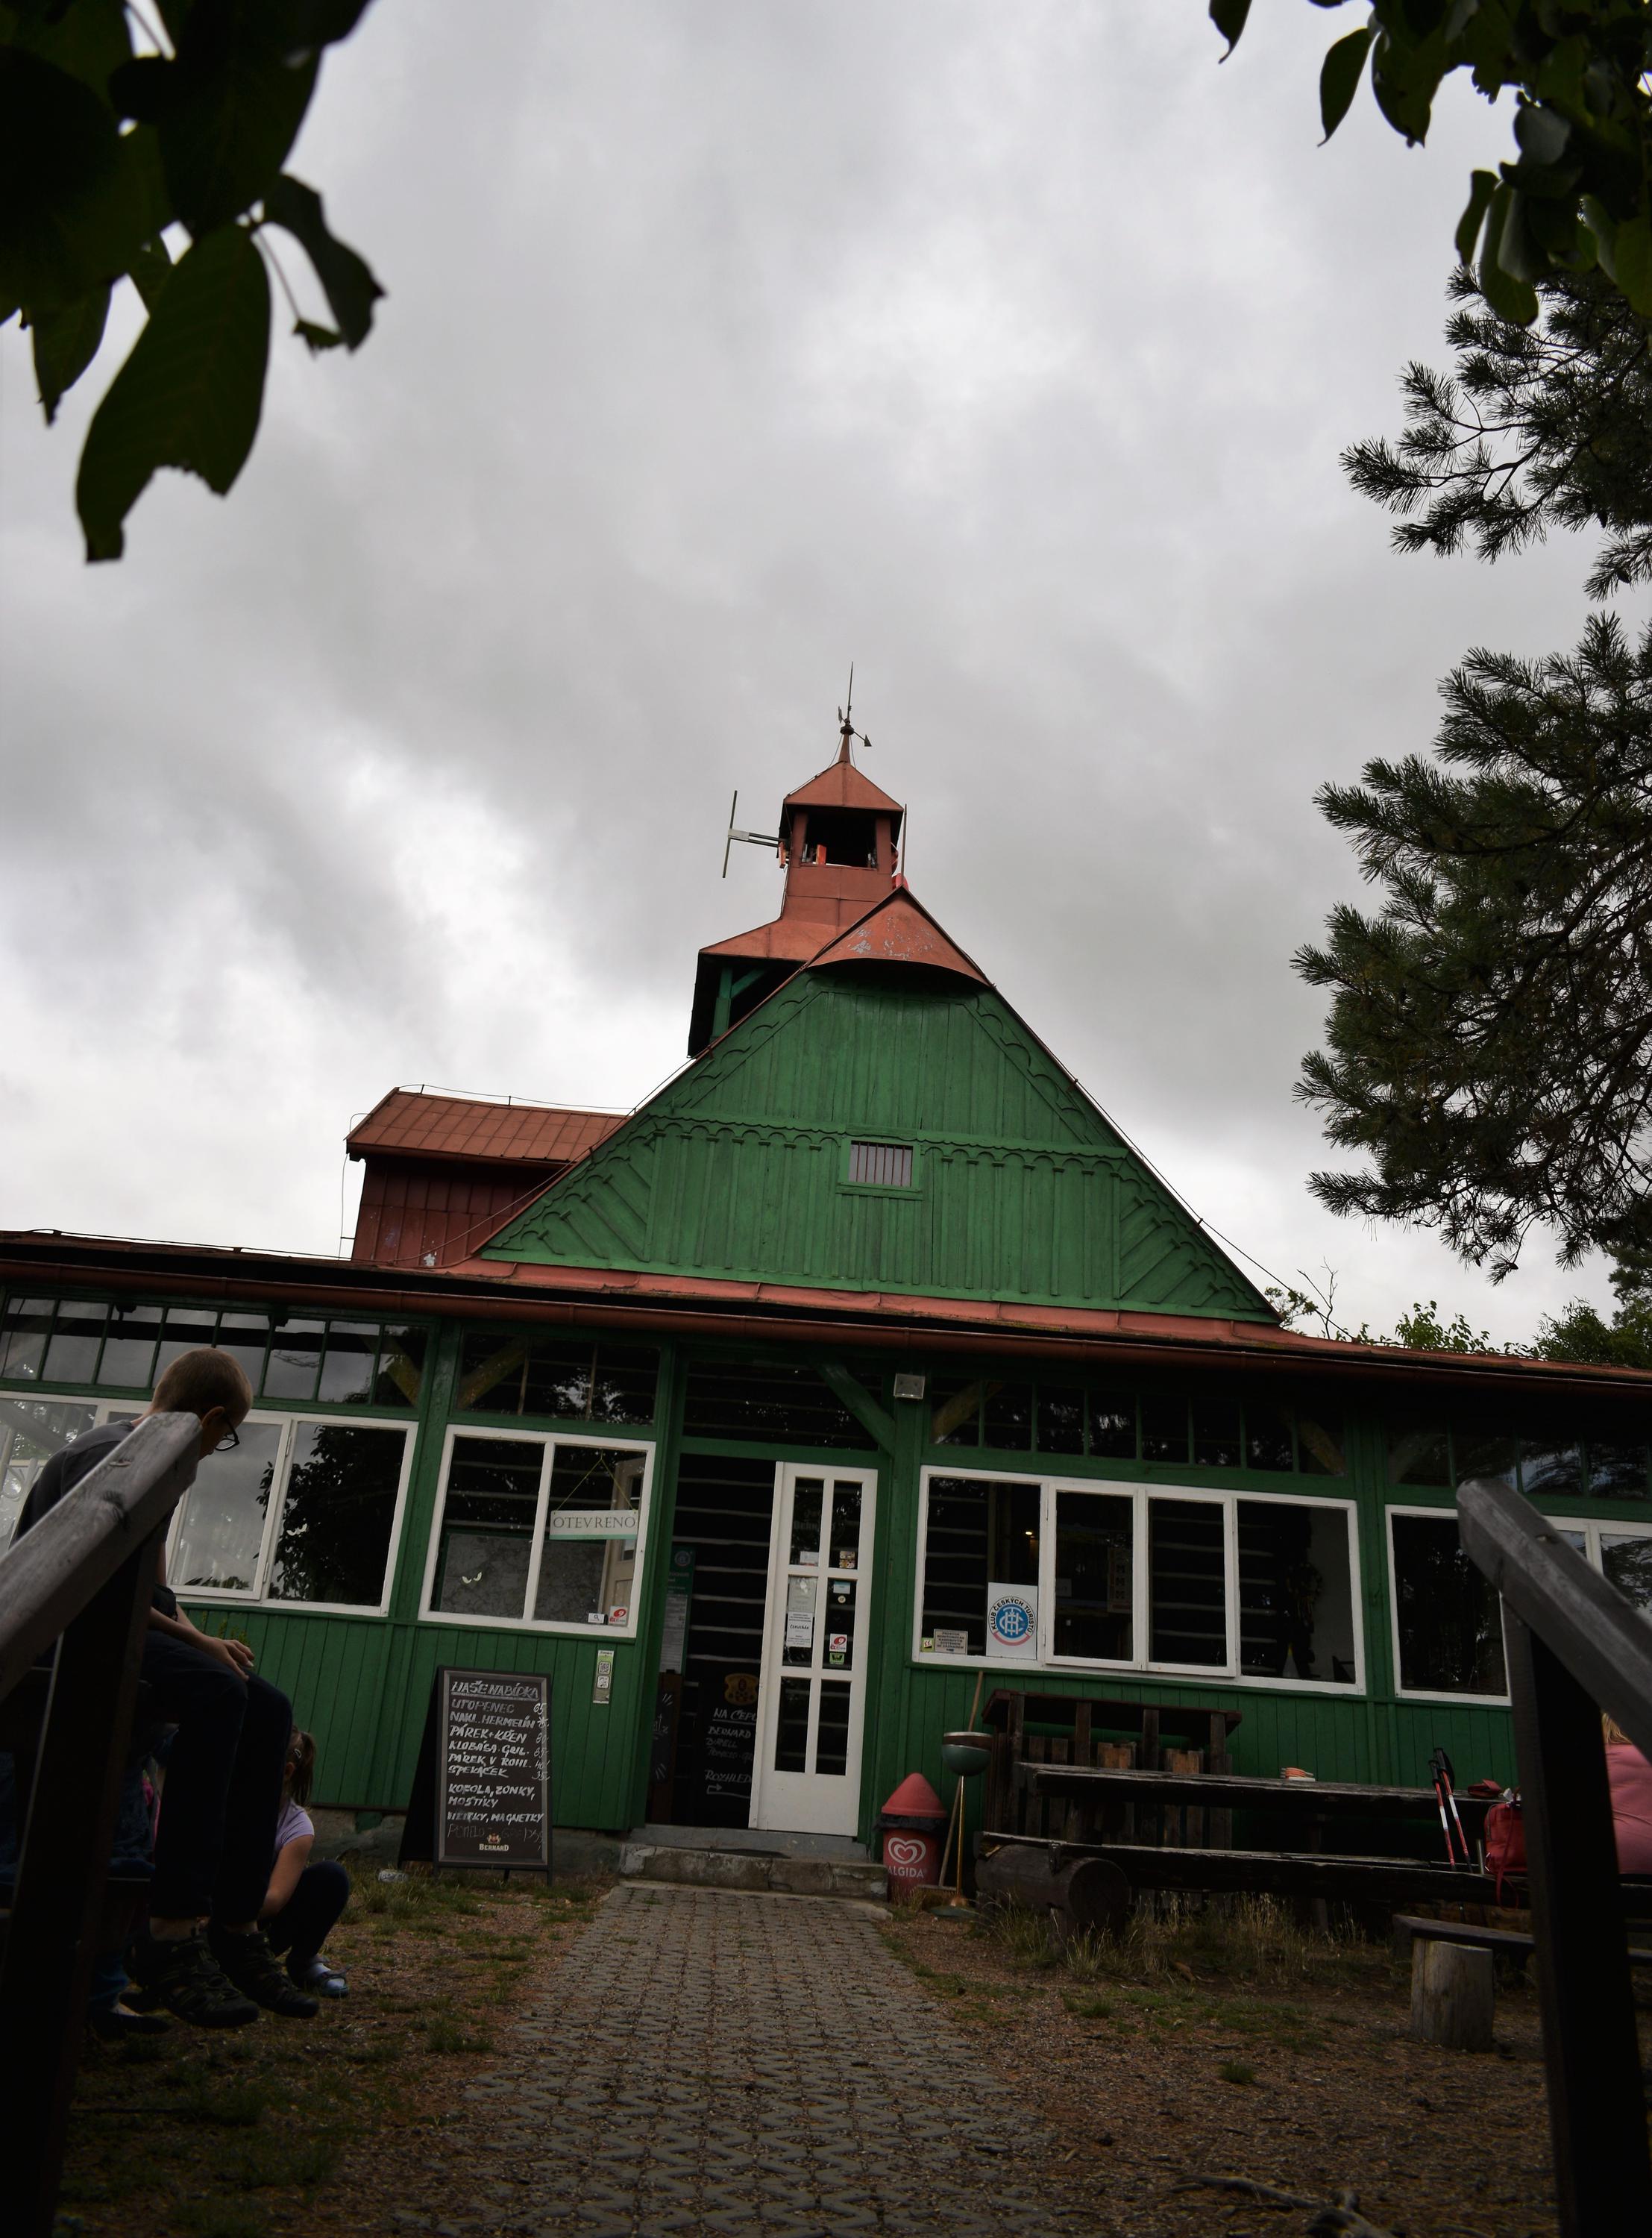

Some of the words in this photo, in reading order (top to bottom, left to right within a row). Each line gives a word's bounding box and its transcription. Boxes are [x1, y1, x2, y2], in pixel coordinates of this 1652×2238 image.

[488, 1682, 538, 1699] NABÍDKA
[451, 1699, 515, 1714] UTOPENEC
[713, 1708, 727, 1719] NA
[481, 1715, 536, 1728] HERMELÍN
[489, 1756, 497, 1765] V
[479, 1843, 509, 1852] BERNARD
[888, 1865, 924, 1878] ALGIDA
